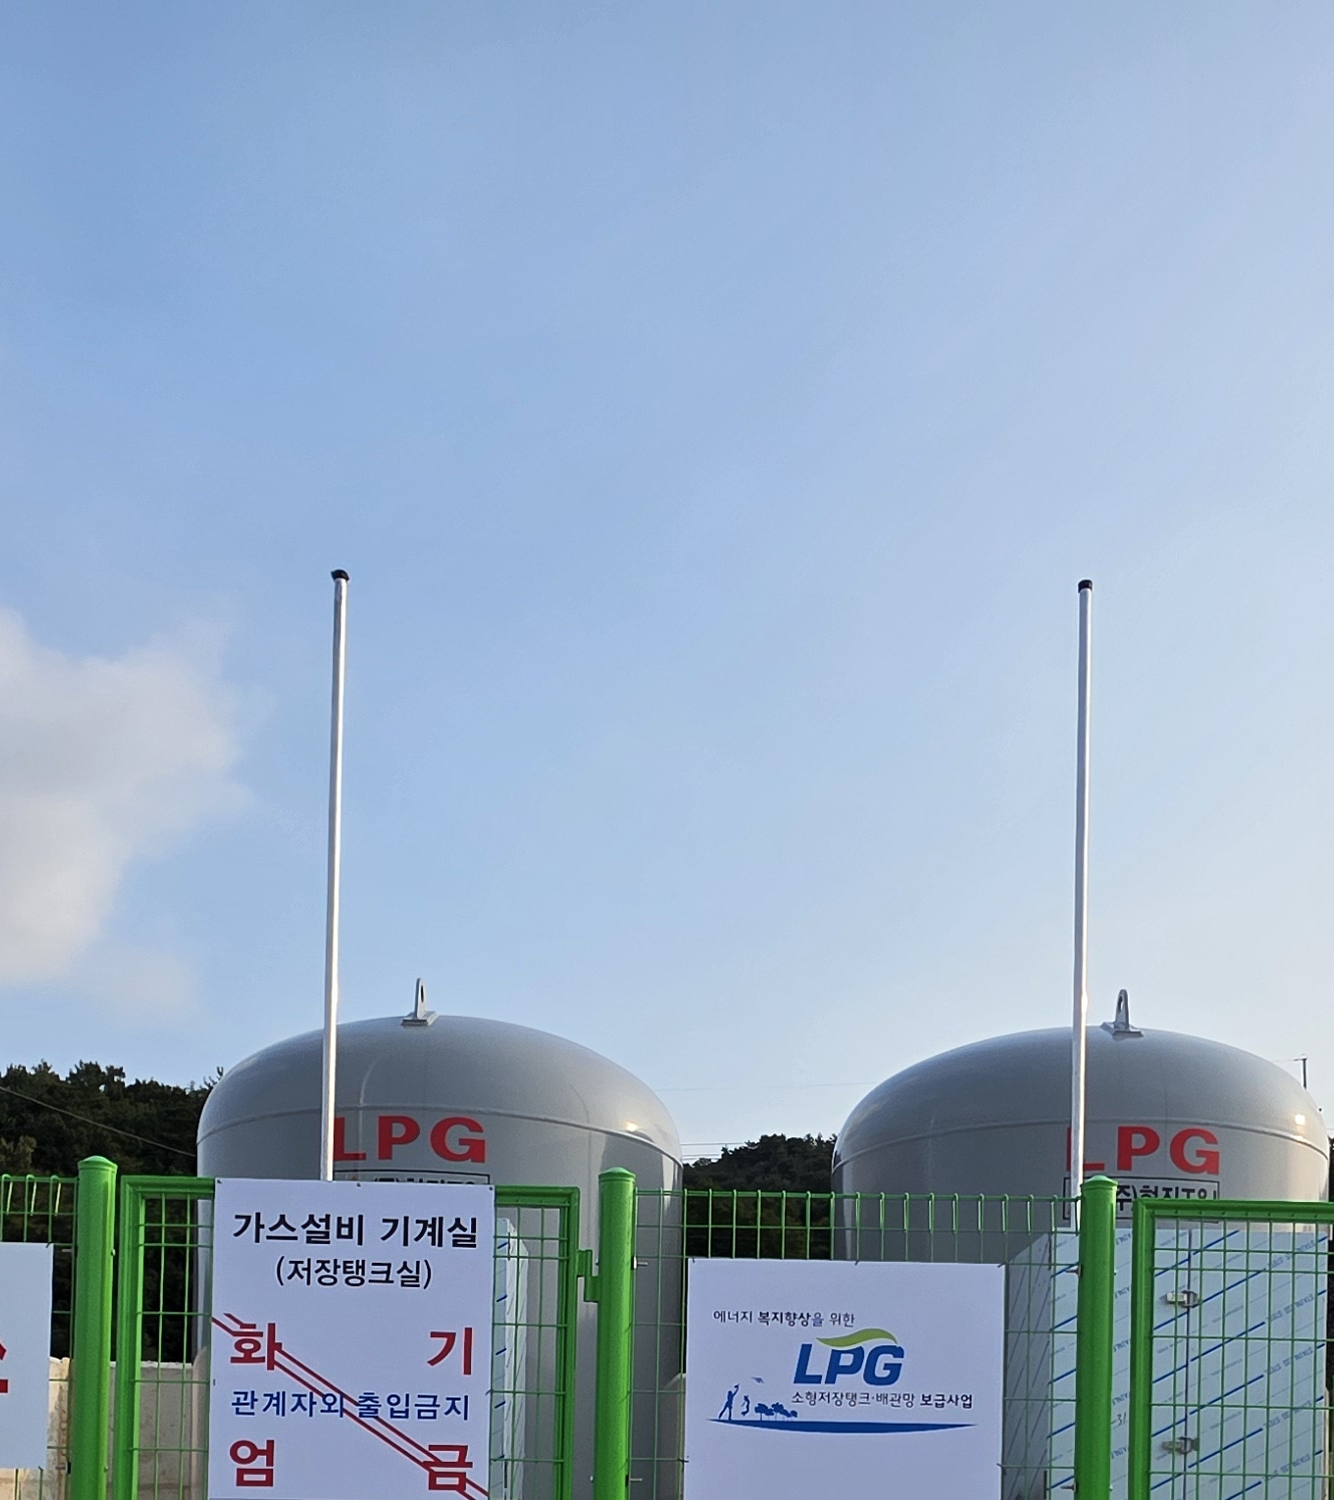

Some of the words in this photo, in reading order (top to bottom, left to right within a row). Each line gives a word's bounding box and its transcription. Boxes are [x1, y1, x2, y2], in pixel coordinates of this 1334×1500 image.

[234, 1212, 363, 1246] 가스설비
[381, 1216, 476, 1248] 기계실
[277, 1256, 431, 1289] (저장탱크실)
[714, 1311, 752, 1323] 에너지
[758, 1312, 824, 1326] 복지향상을
[830, 1313, 854, 1327] 위한
[793, 1343, 904, 1386] LPG
[232, 1387, 348, 1418] 관계자외
[354, 1393, 468, 1424] 출입금지
[920, 1394, 972, 1408] 보급사업
